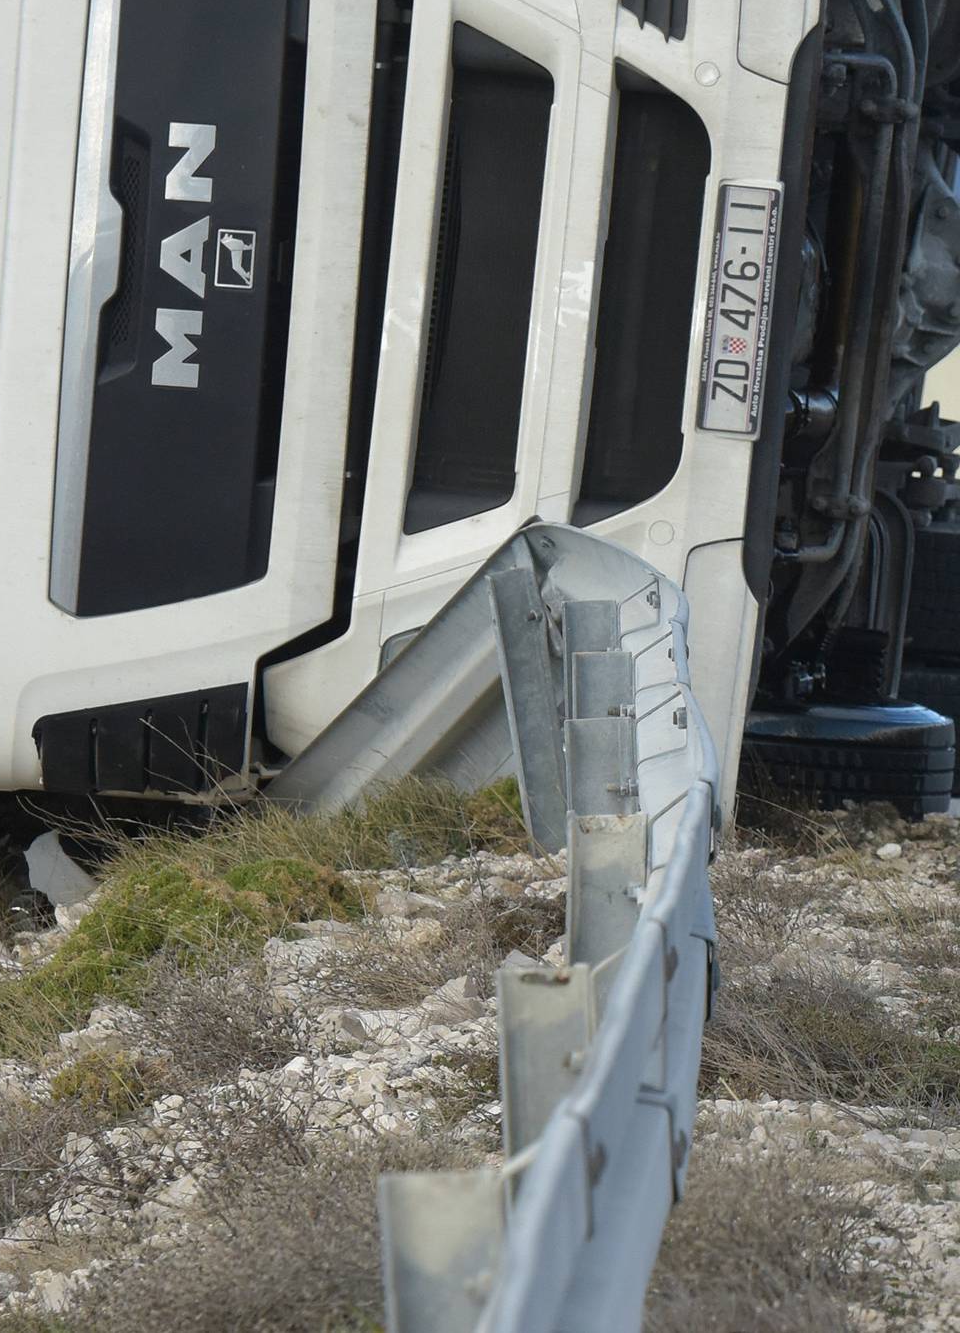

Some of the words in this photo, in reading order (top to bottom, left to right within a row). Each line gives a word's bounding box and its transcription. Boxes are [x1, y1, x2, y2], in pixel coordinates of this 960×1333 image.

[769, 207, 777, 233] d.o.o.
[151, 121, 217, 388] MAN
[767, 235, 775, 263] centri
[763, 266, 772, 302] servisni
[758, 305, 768, 347] Prodajno
[711, 359, 749, 403] ZD
[754, 350, 764, 393] Hrvatska
[750, 395, 759, 417] Auto
